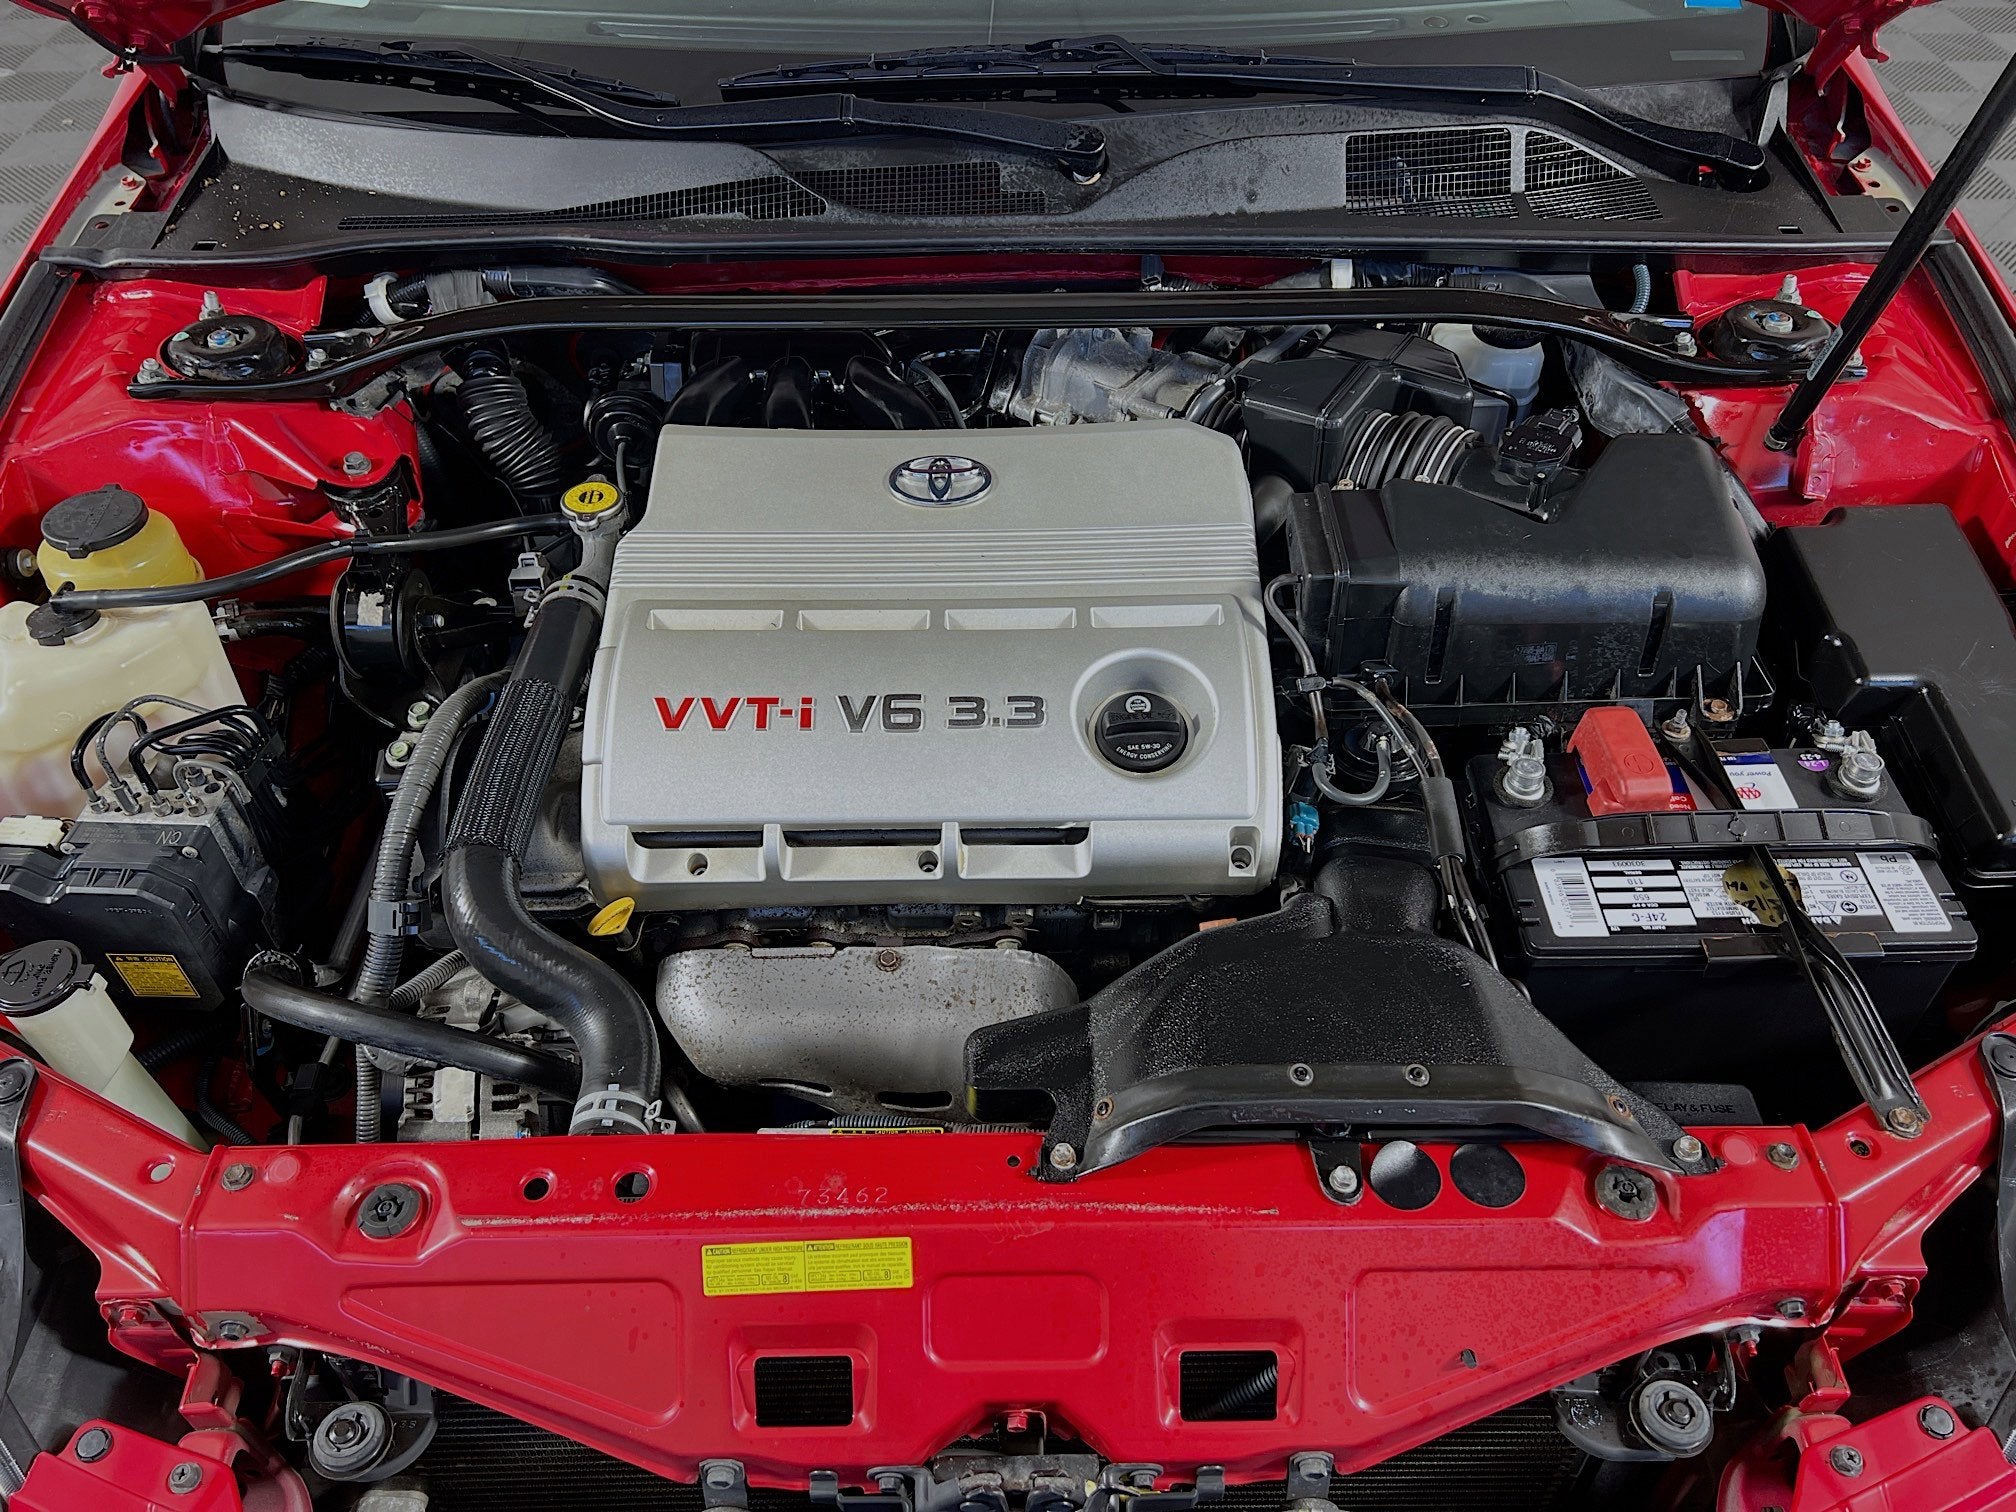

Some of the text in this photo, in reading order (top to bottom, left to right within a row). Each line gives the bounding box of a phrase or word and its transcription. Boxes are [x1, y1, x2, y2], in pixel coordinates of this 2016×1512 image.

[654, 694, 1046, 732] VVT-i V6 3.3
[1116, 743, 1173, 760] ENERGY CONSERVING
[1880, 855, 1898, 863] Pb
[1631, 912, 1667, 922] 24F-C
